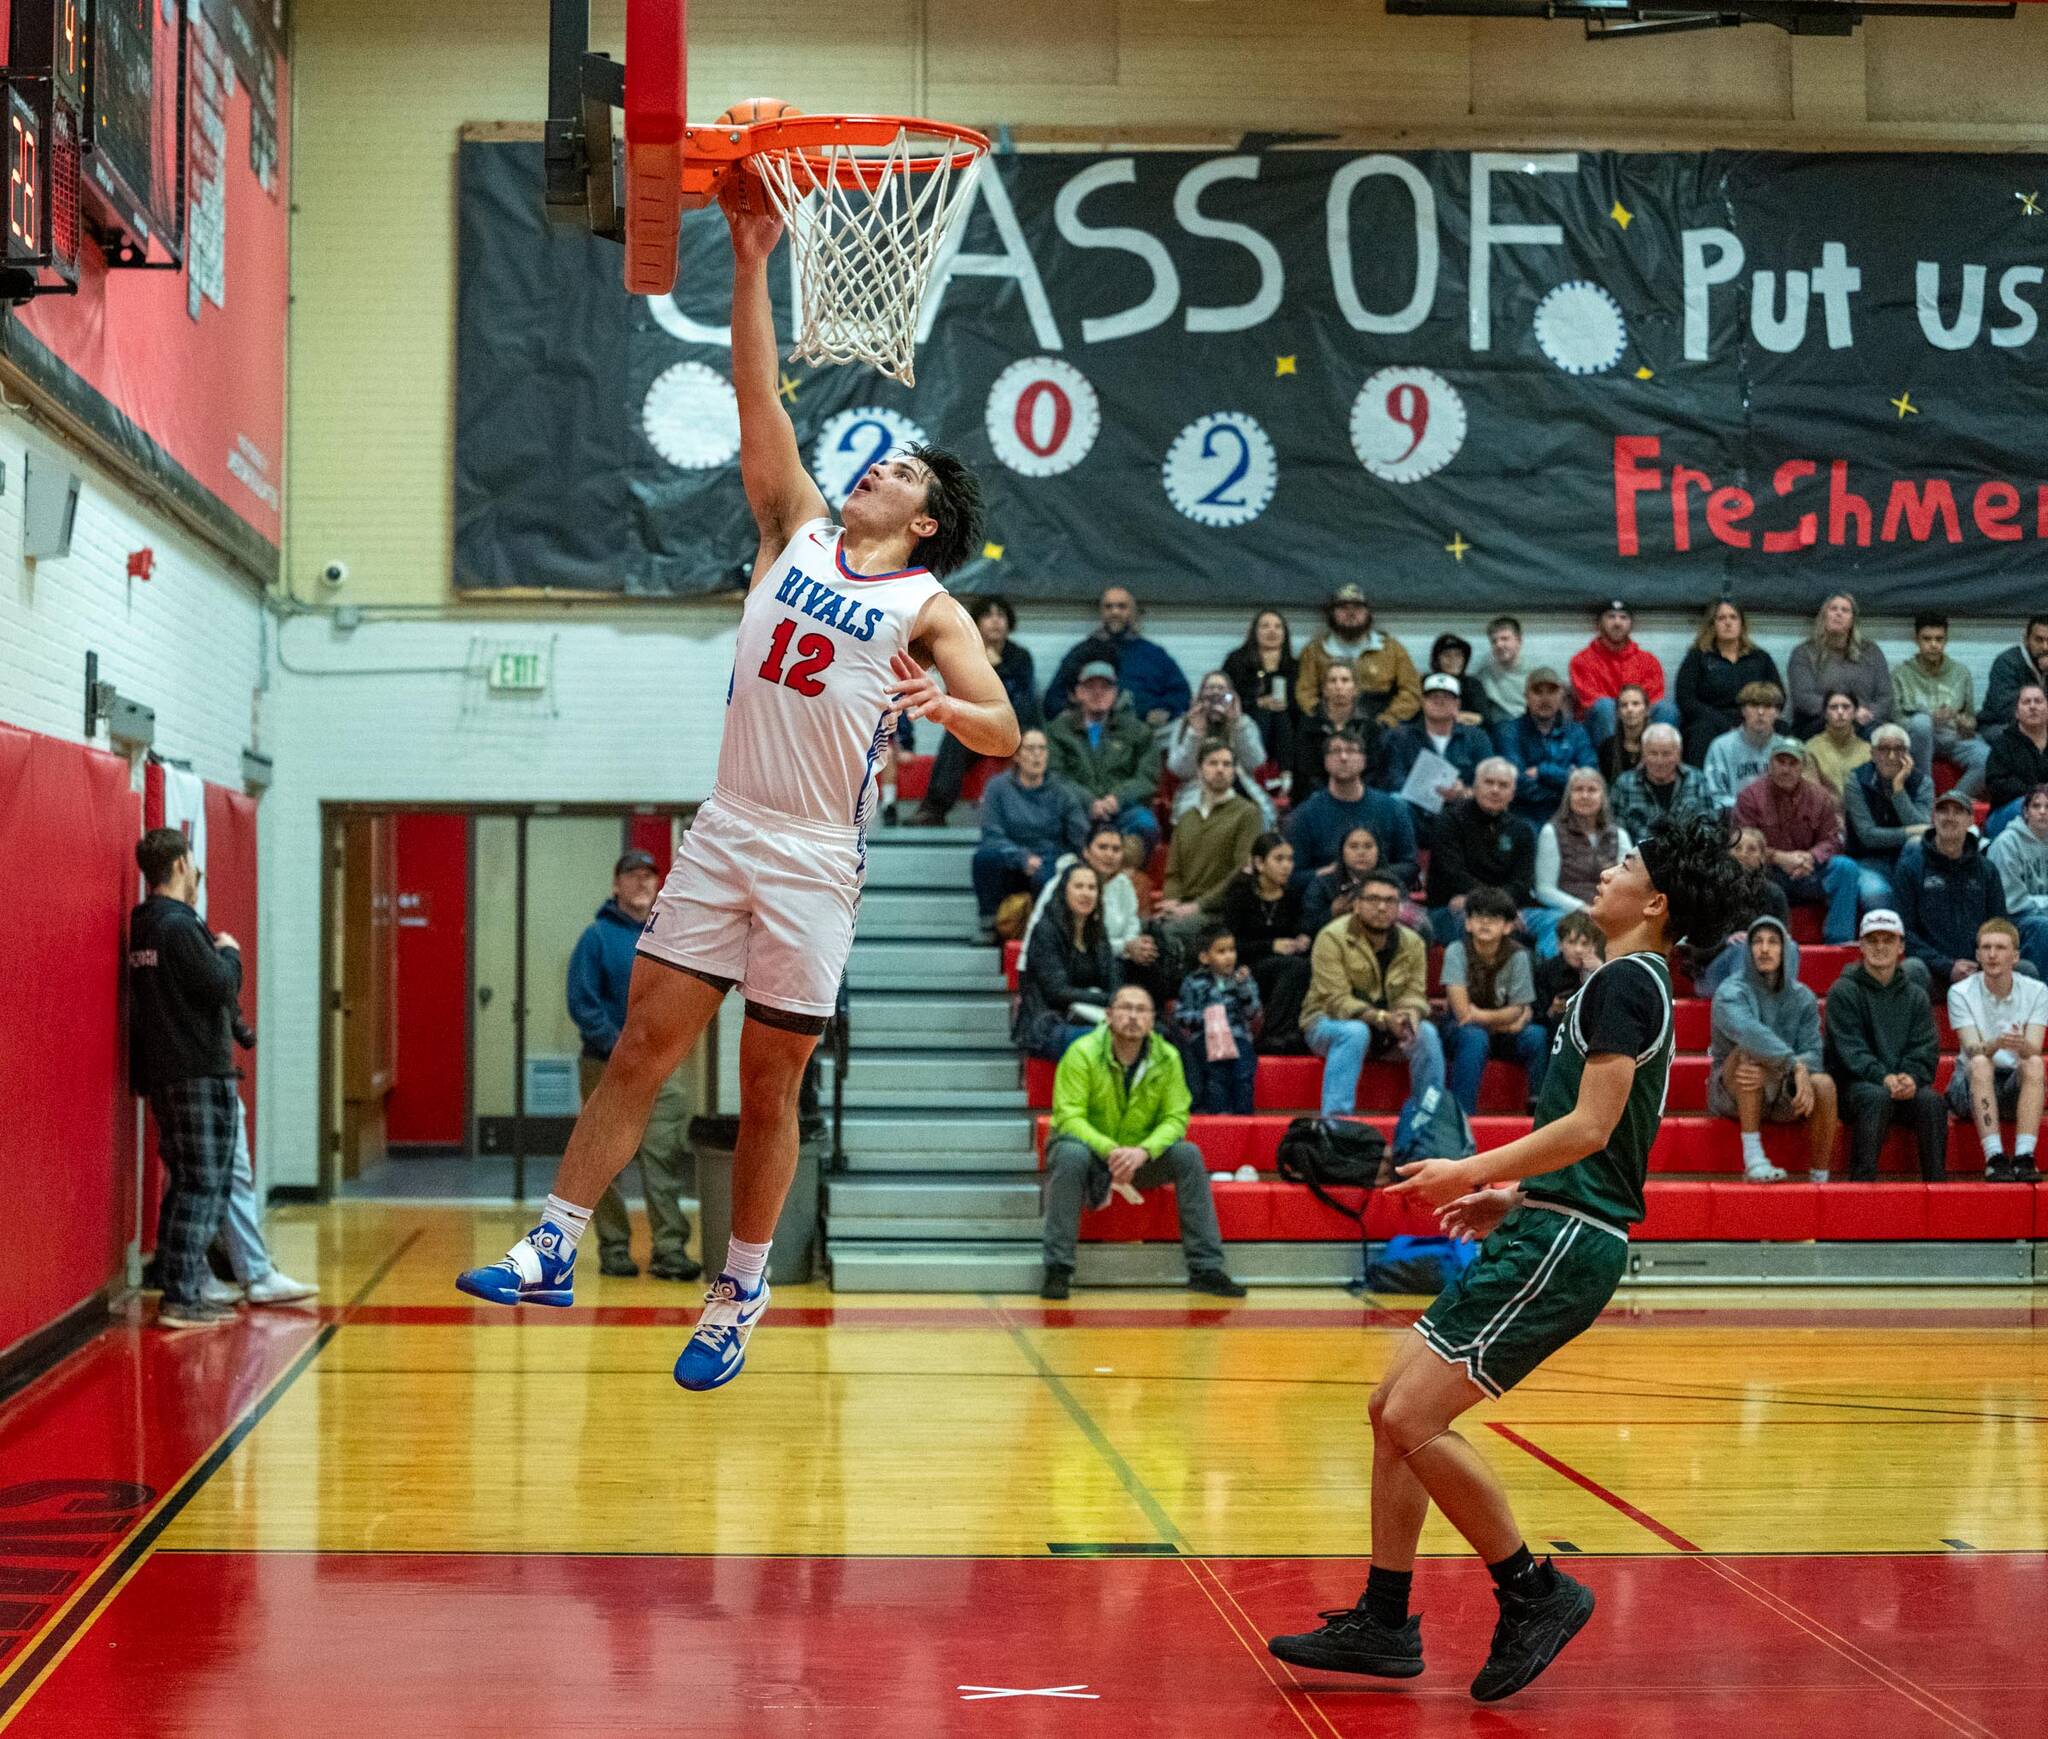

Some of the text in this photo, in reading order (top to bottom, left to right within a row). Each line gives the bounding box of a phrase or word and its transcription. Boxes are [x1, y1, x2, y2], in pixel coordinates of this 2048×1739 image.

[1325, 153, 1580, 352] OF
[1681, 226, 2046, 362] Put us
[774, 565, 884, 642] RIVALS
[499, 654, 539, 689] EXIT
[757, 617, 836, 698] 12
